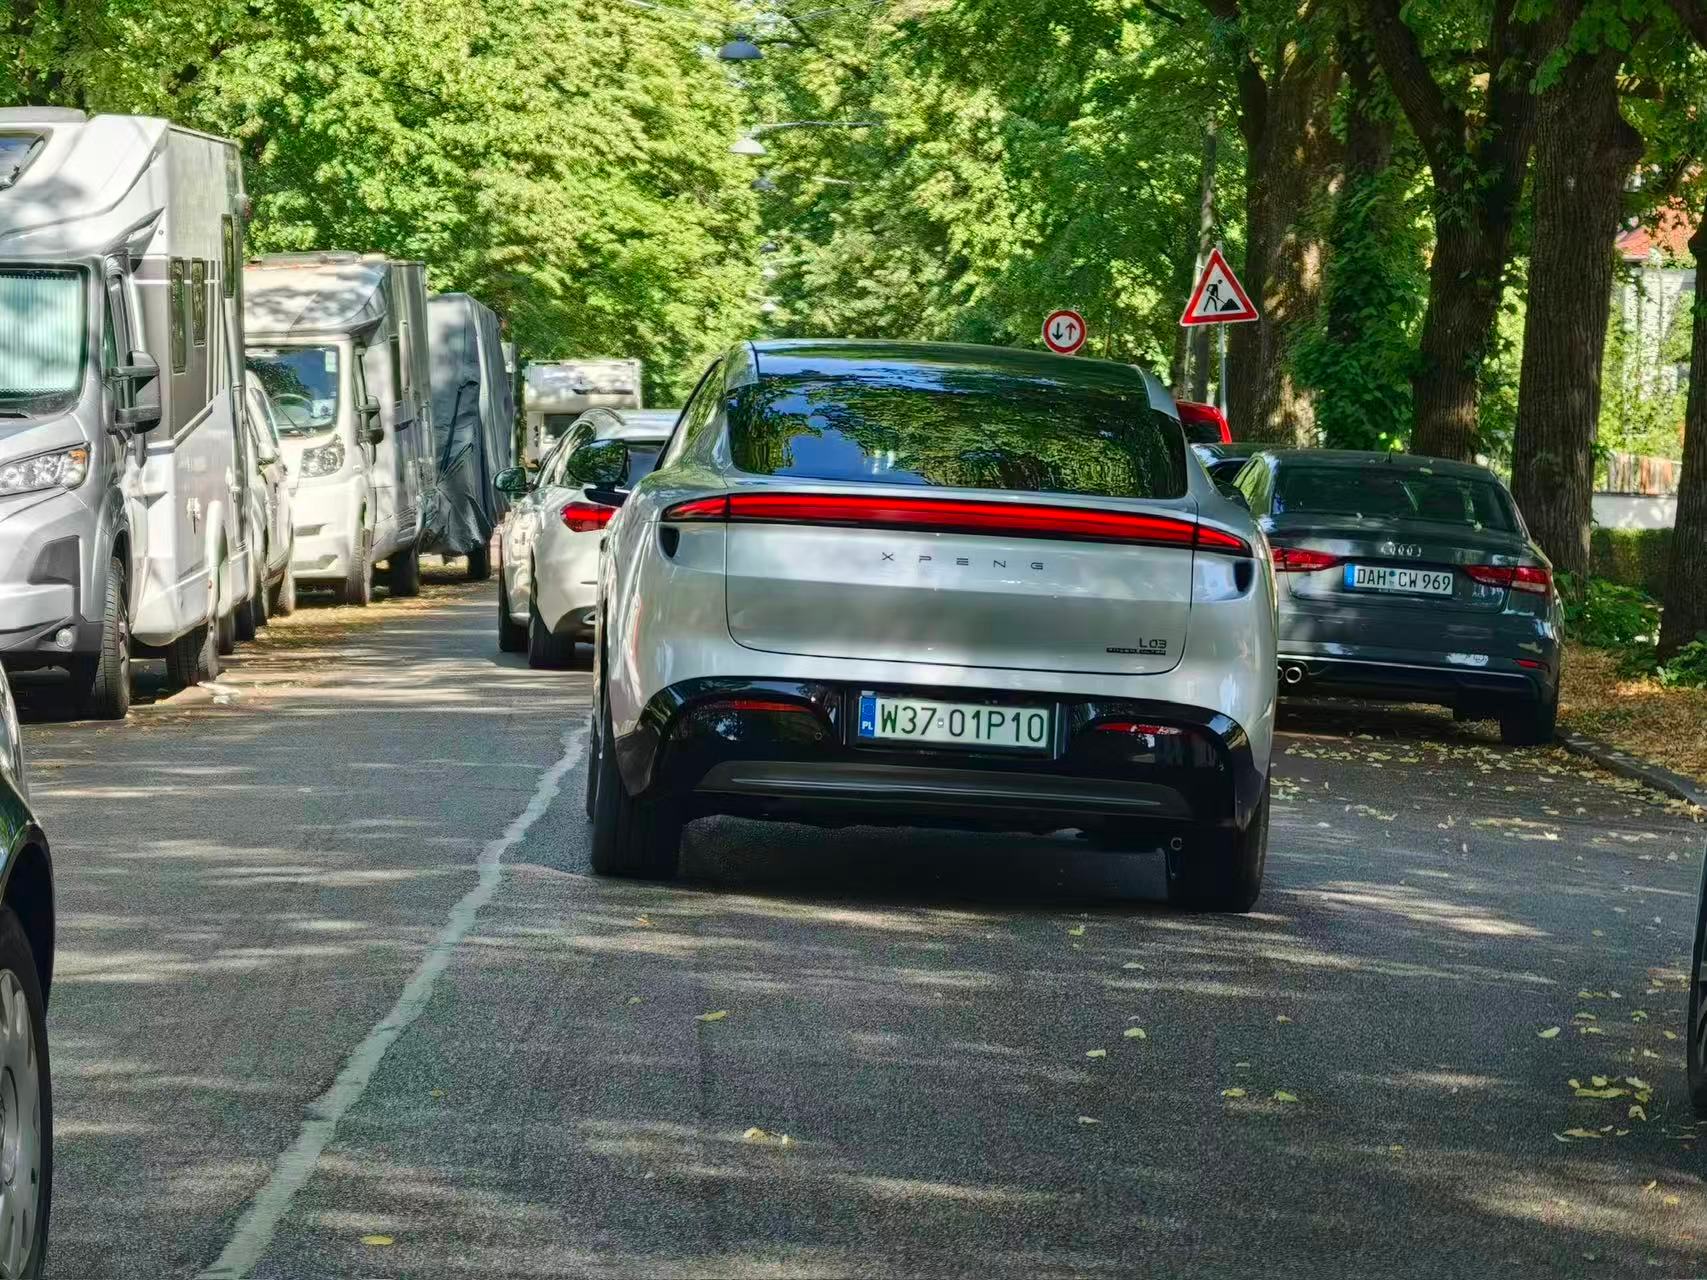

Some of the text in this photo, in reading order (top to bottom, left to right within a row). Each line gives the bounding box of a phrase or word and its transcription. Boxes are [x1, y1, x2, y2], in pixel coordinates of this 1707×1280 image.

[882, 552, 1044, 570] XPENG
[1356, 568, 1451, 591] DAH CW 969
[862, 721, 873, 730] PL
[881, 704, 937, 735] W37
